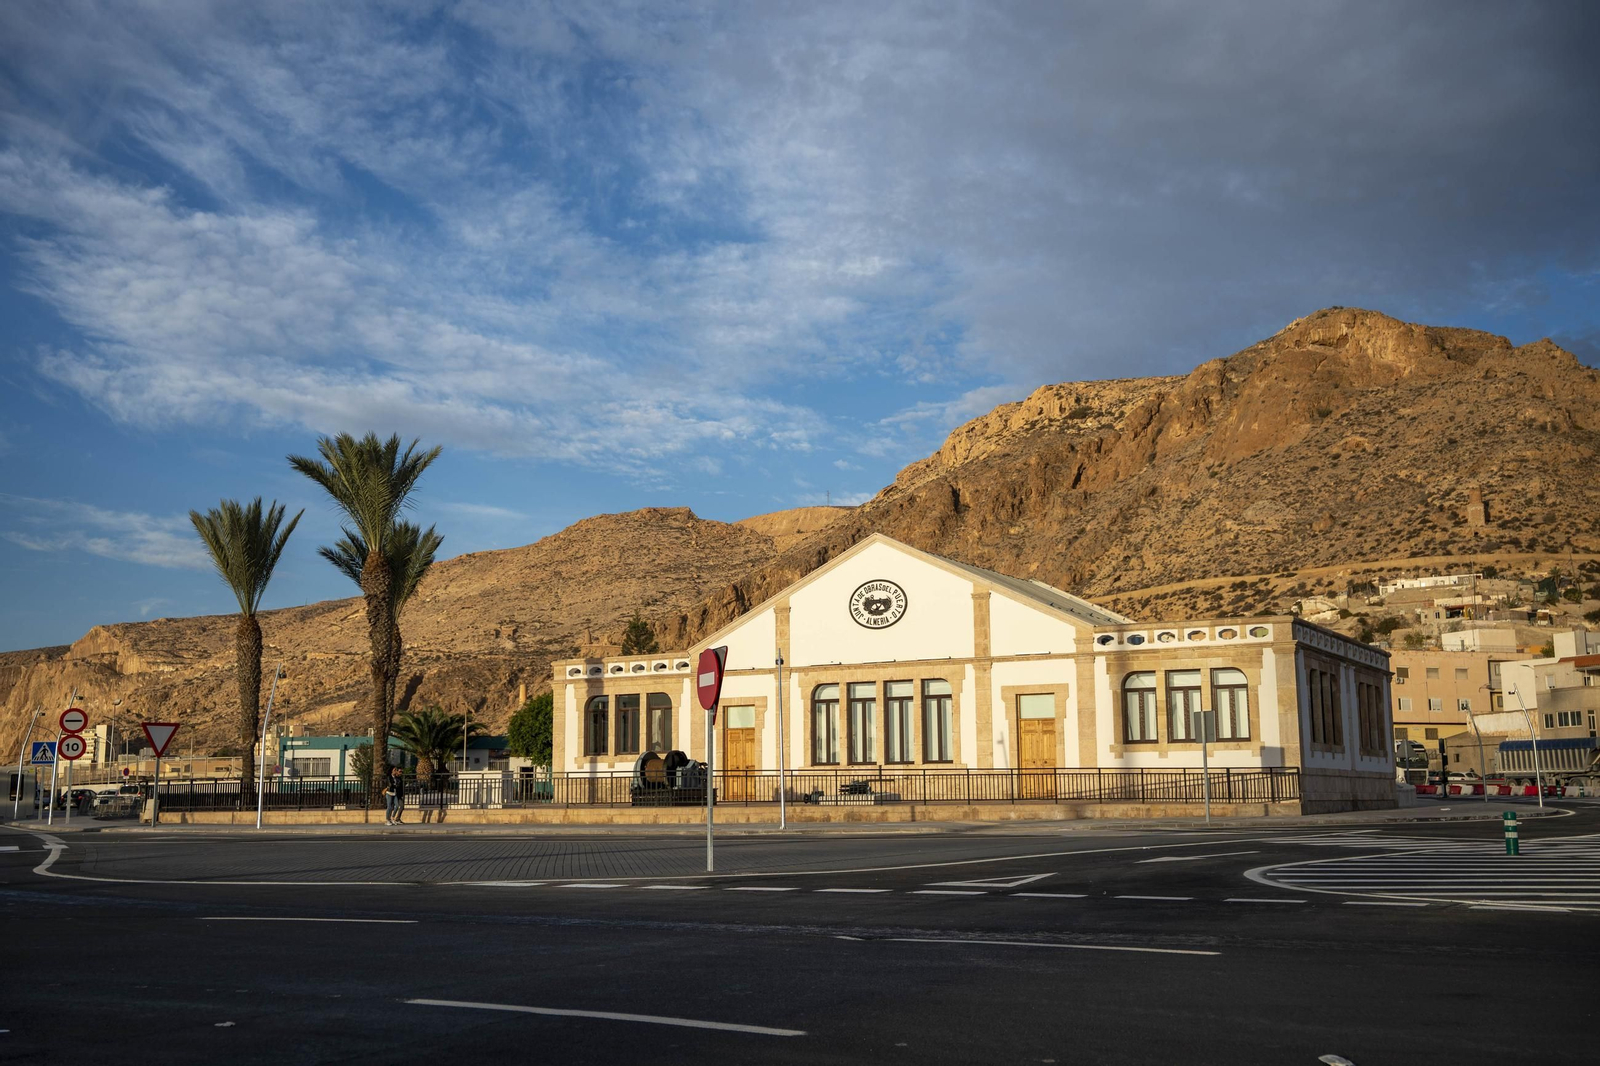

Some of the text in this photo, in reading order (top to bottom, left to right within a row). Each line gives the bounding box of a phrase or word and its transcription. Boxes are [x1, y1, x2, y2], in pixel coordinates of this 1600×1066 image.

[857, 591, 865, 599] DE
[853, 598, 864, 619] JUNTA
[892, 589, 903, 618] PUERTO
[66, 743, 79, 751] 10
